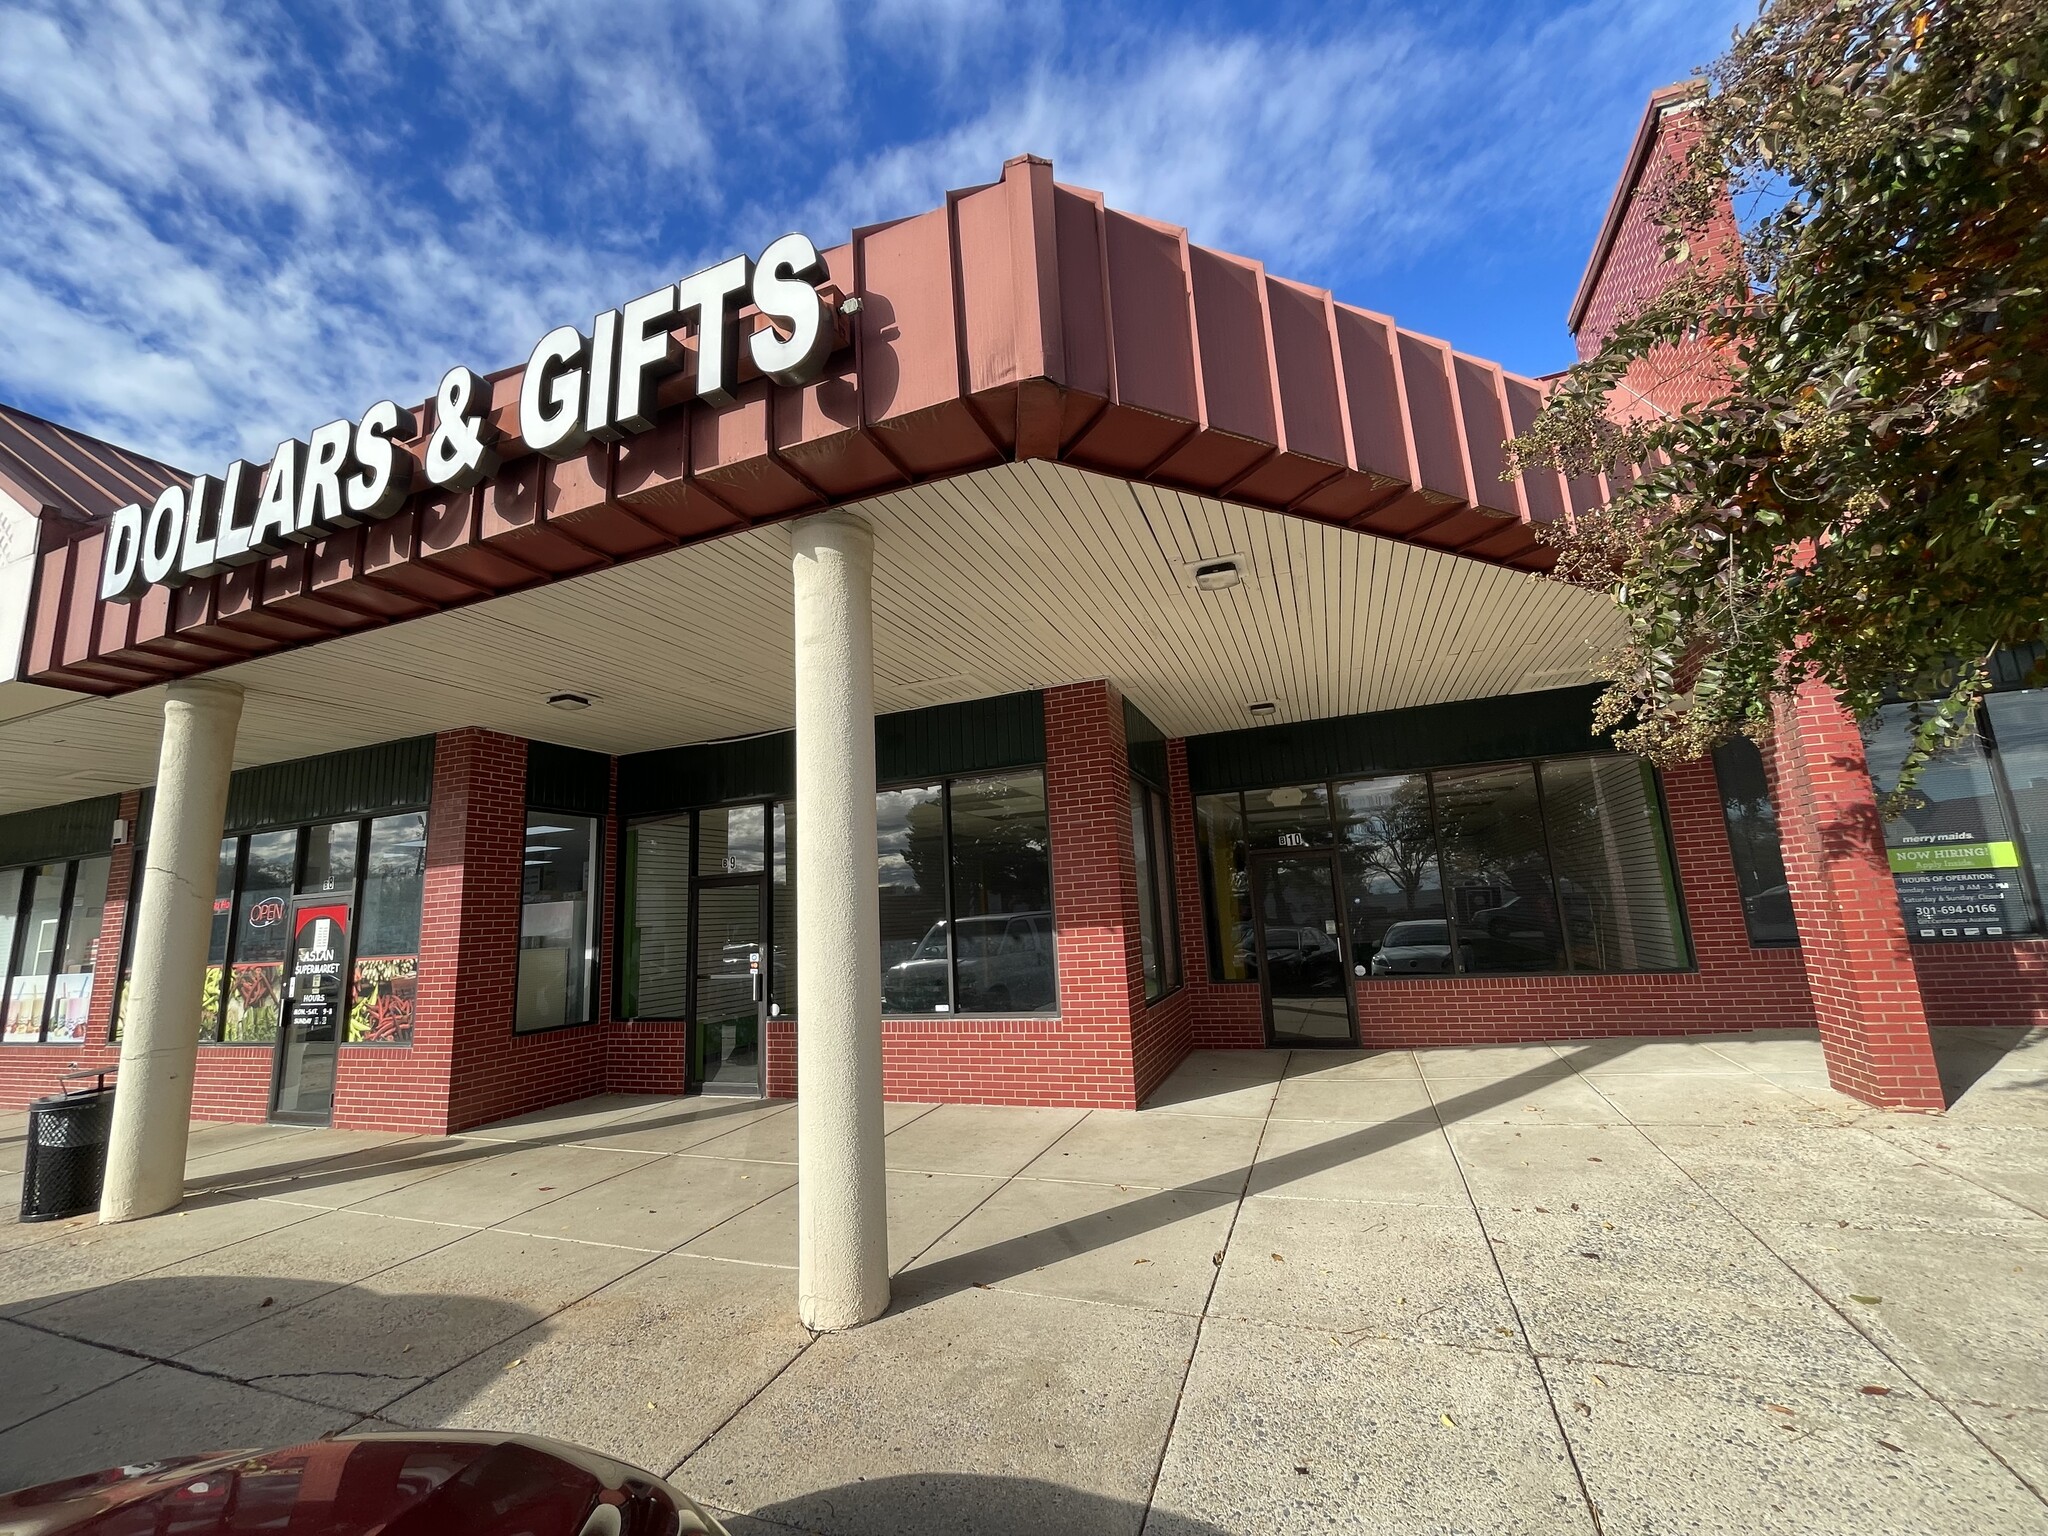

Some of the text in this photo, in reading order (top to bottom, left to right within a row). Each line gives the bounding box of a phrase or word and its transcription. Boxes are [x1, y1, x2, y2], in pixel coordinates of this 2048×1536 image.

[101, 232, 824, 602] DOLLARS & GIFTS
[1903, 835, 1935, 843] merry
[1896, 847, 1989, 861] NOW HIRING!
[1915, 861, 1942, 869] Apply
[1901, 876, 1931, 884] HOURS
[1945, 873, 1995, 882] OPERATION:
[250, 903, 284, 922] OPEN
[1916, 904, 1996, 915] 301-694-0166
[304, 949, 334, 961] ASIAN
[295, 962, 340, 975] SUPERMARKET
[303, 994, 325, 1002] HOURS
[293, 1017, 312, 1025] SUNDAY
